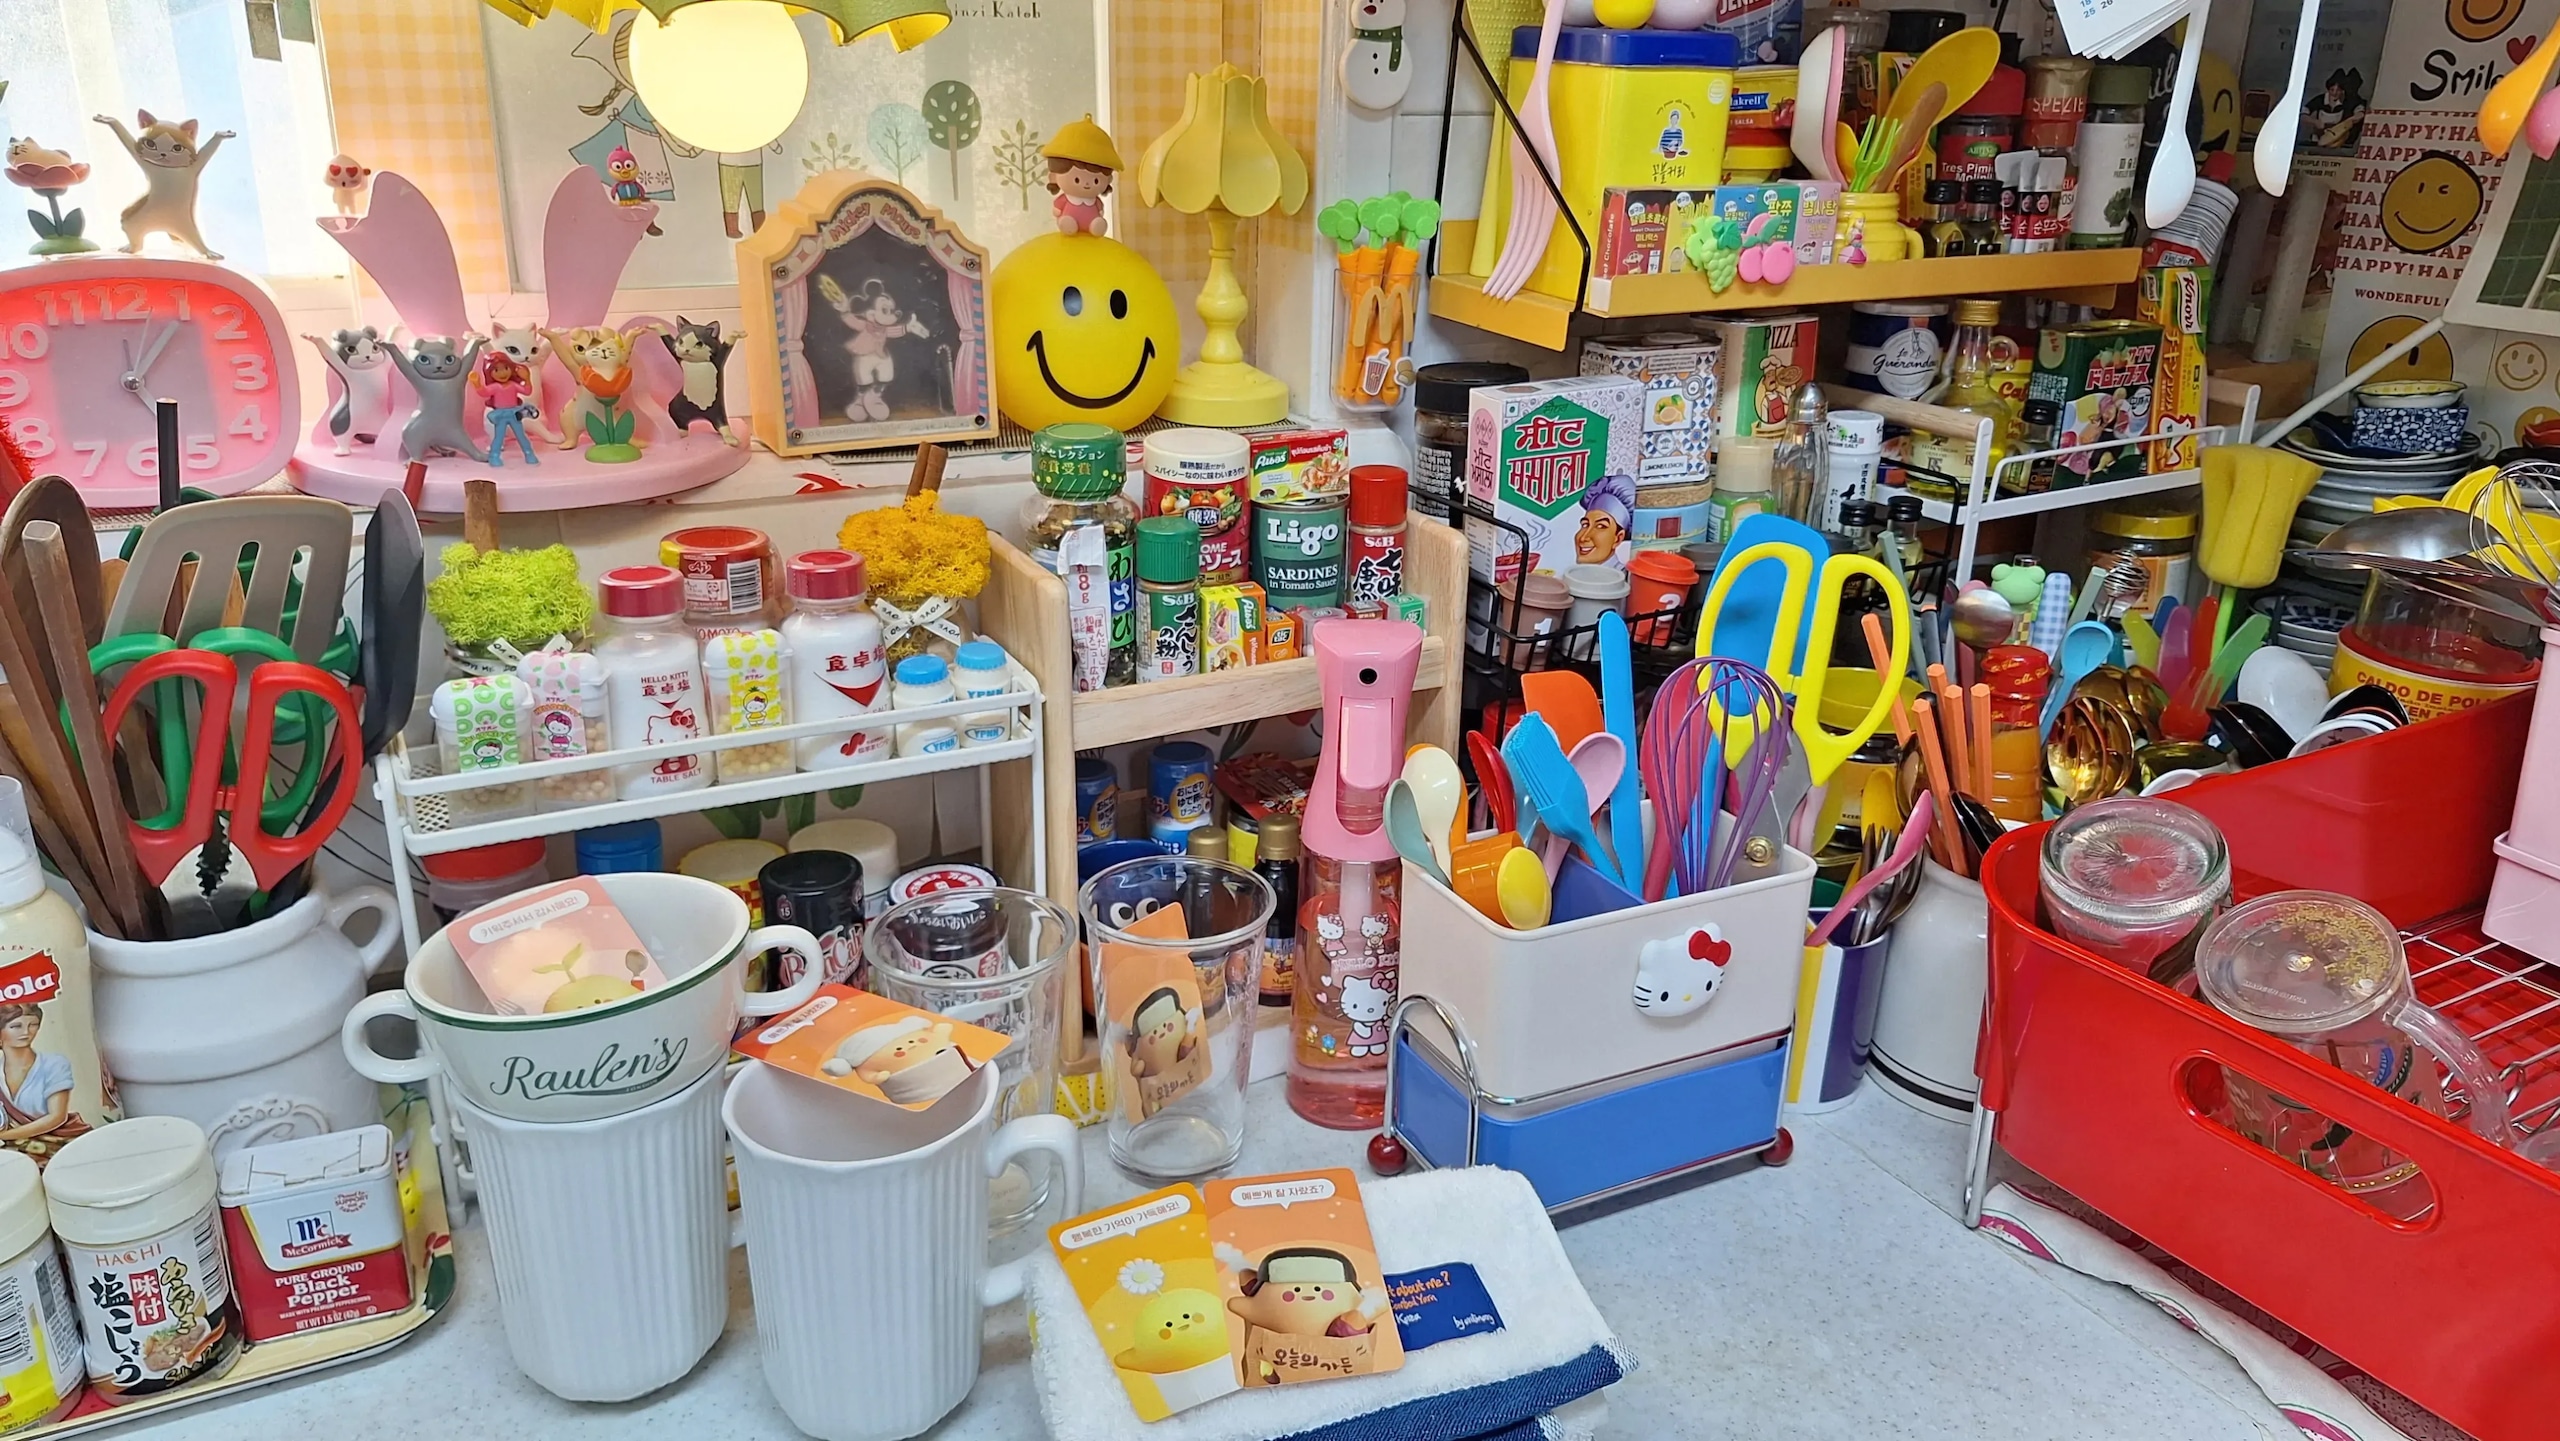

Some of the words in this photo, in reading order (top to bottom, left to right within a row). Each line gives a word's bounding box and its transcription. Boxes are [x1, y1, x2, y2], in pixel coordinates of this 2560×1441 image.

[992, 1, 1042, 19] Katoh
[2082, 8, 2096, 19] 25
[1730, 96, 1763, 107] akrell
[2363, 123, 2446, 141] HAPPY!
[1942, 162, 1963, 173] Tres
[828, 201, 871, 241] Mickey
[880, 202, 922, 241] Mouse
[1801, 201, 1838, 216] 별사탕
[1604, 213, 1617, 261] Chocolate
[2336, 256, 2414, 276] HAPPY!
[34, 289, 86, 326] 11
[88, 283, 152, 321] 12
[166, 285, 191, 321] 1
[2181, 272, 2196, 331] Knorr
[2354, 288, 2442, 308] WONDERFUL
[211, 304, 249, 341] 2
[1763, 324, 1800, 351] PIZZA
[230, 353, 269, 391] 3
[2085, 363, 2151, 392] ドロップス
[0, 369, 31, 408] 9
[228, 404, 269, 442] 4
[1514, 414, 1588, 453] मीट
[13, 417, 57, 458] 8
[1032, 441, 1105, 461] ンドセレクション
[73, 440, 109, 478] 7
[126, 440, 159, 477] 6
[186, 434, 221, 470] 5
[1254, 451, 1288, 470] คนอร์
[1507, 449, 1591, 508] मसाला
[1266, 517, 1339, 556] Ligo
[1363, 536, 1395, 548] S&B
[1267, 564, 1339, 581] SARDINES
[1270, 579, 1279, 589] in
[1279, 578, 1315, 590] Tomato
[1315, 577, 1338, 589] Sauce
[1109, 551, 1134, 643] わさび
[1162, 592, 1196, 607] S&B
[1154, 627, 1180, 660] の粉
[640, 674, 668, 685] HELLO
[669, 671, 690, 683] KITTY
[641, 679, 692, 698] 食卓塩
[2416, 689, 2445, 706] DE
[650, 770, 680, 786] TABLE
[681, 767, 703, 781] SALT
[780, 907, 792, 918] 15
[1331, 956, 1377, 973] HELLO
[1378, 952, 1400, 967] KIT
[489, 1036, 689, 1102] Raulen's
[1241, 1189, 1273, 1201] 예쁘게
[1275, 1188, 1286, 1200] 잘
[1288, 1184, 1325, 1197] 자랐죠?
[1071, 1225, 1103, 1243] 행복한
[1104, 1212, 1136, 1232] 기억이
[1138, 1201, 1181, 1223] 가득해요!
[95, 1242, 163, 1268] HACHI
[284, 1236, 344, 1258] McCormick
[275, 1273, 309, 1288] PURE
[311, 1261, 366, 1281] GROUND
[293, 1273, 352, 1297] Black
[131, 1270, 166, 1324] 味付
[287, 1283, 360, 1309] Pepper
[87, 1270, 143, 1387] 塩こしょう
[296, 1320, 309, 1331] NET
[1272, 1346, 1319, 1370] 오늘의
[1320, 1356, 1354, 1375] 가든
